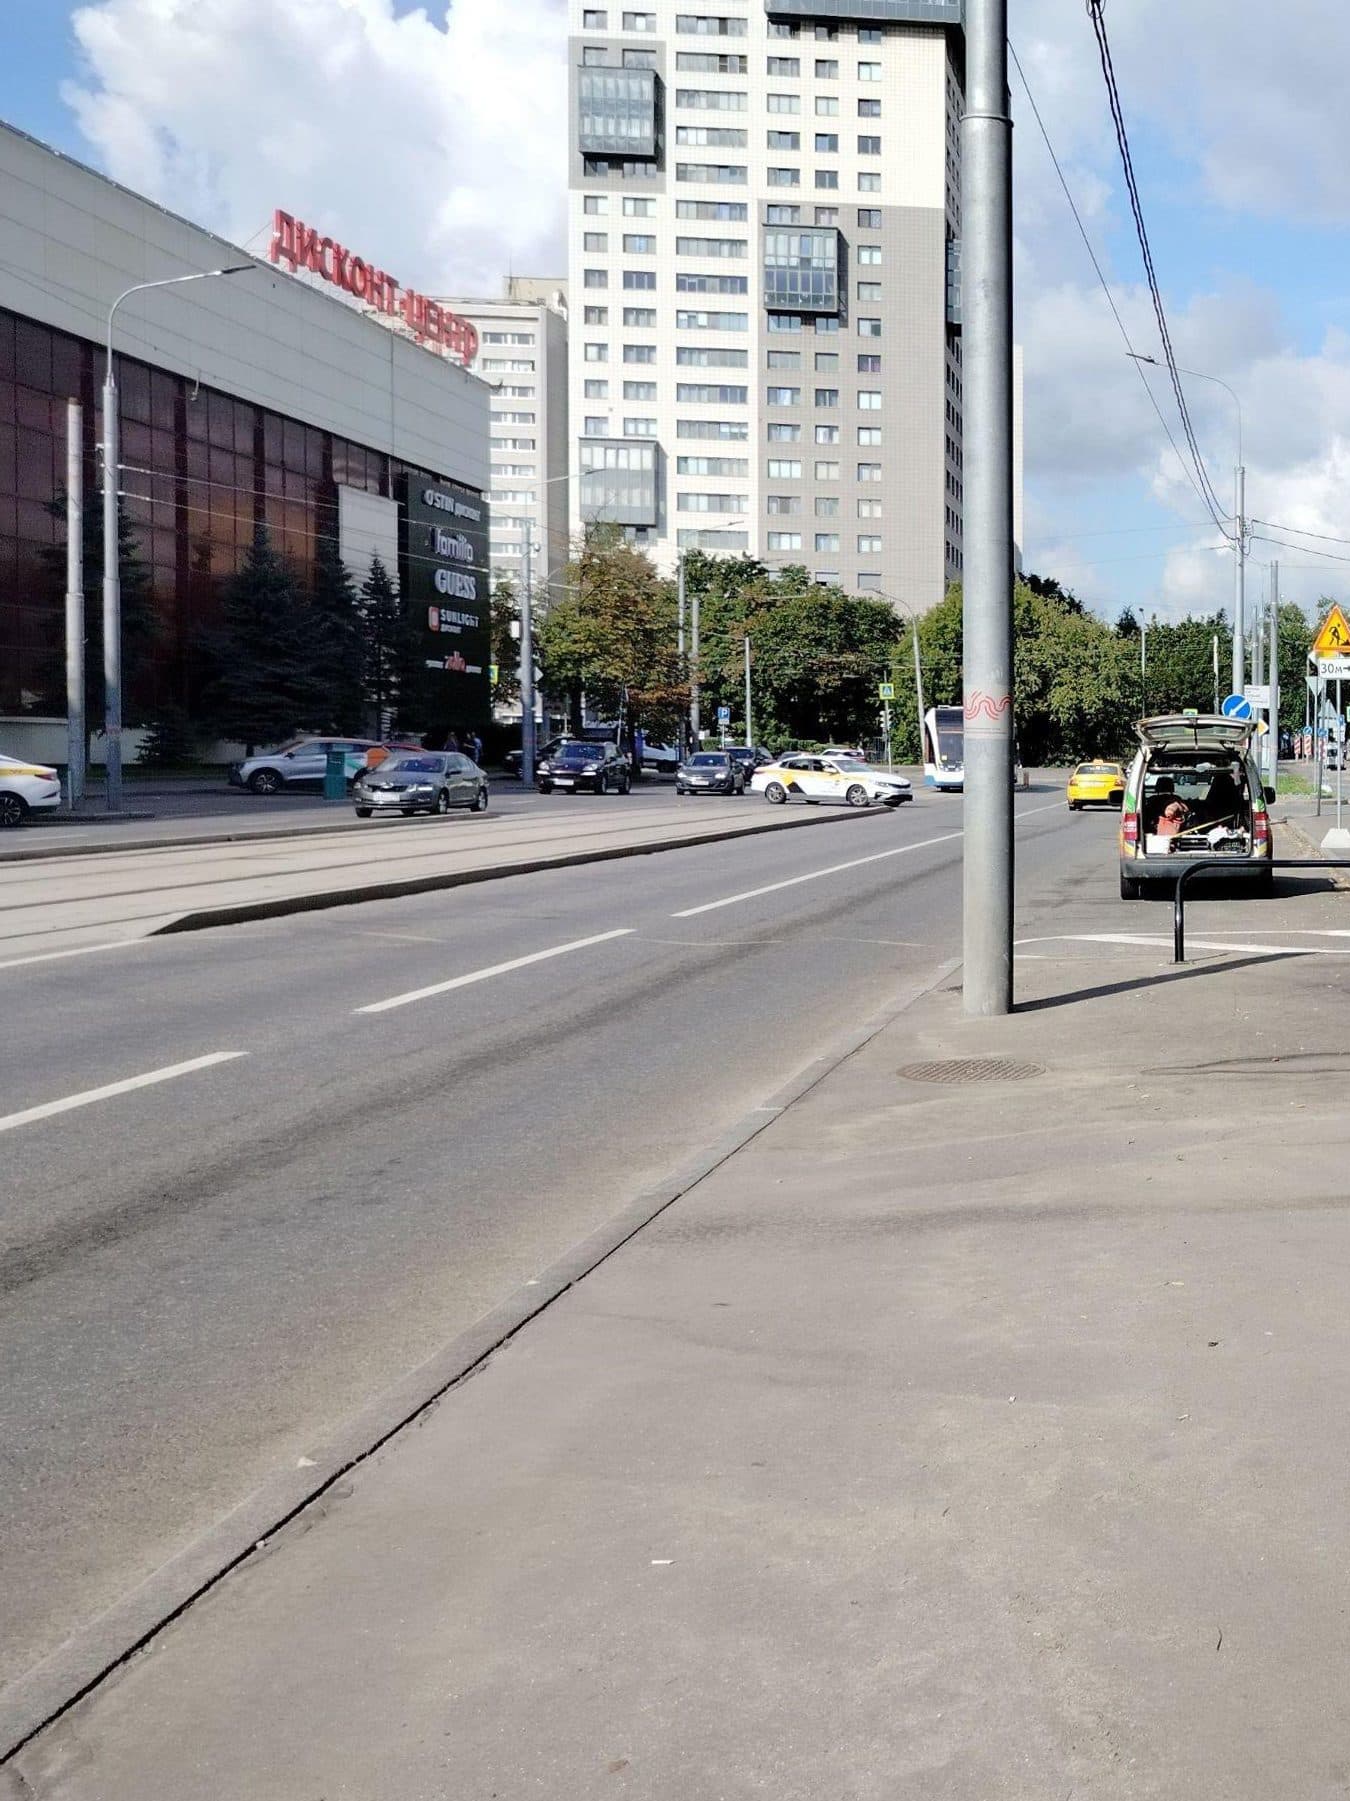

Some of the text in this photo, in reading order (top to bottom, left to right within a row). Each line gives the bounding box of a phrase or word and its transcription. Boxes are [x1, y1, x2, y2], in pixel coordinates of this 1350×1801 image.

[269, 208, 479, 367] ДИСКОНТ-ЦЕНТР
[434, 568, 477, 600] GUESS
[440, 608, 480, 628] SUNLIGHT
